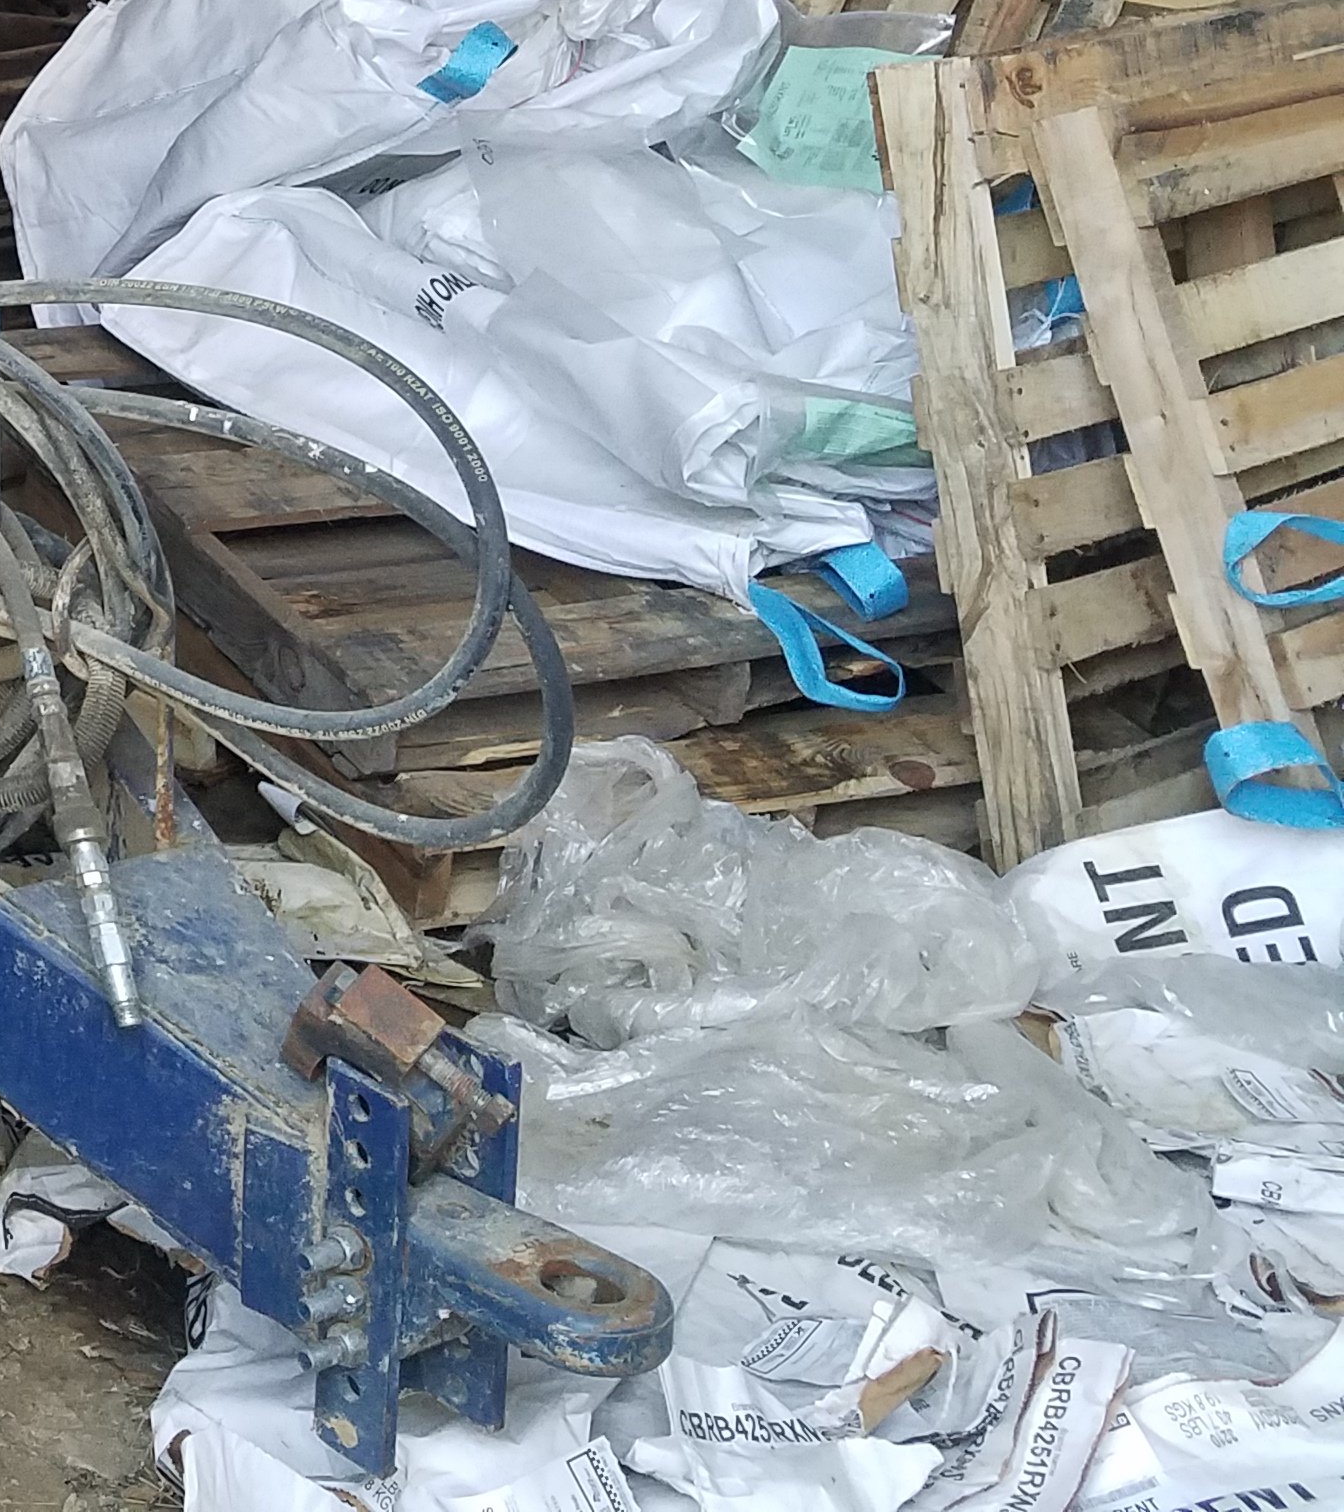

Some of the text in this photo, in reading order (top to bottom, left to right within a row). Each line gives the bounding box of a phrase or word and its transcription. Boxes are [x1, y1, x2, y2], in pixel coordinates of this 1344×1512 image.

[432, 402, 453, 424] ISO
[1164, 1396, 1195, 1423] KGS
[1179, 1417, 1208, 1440] LBS
